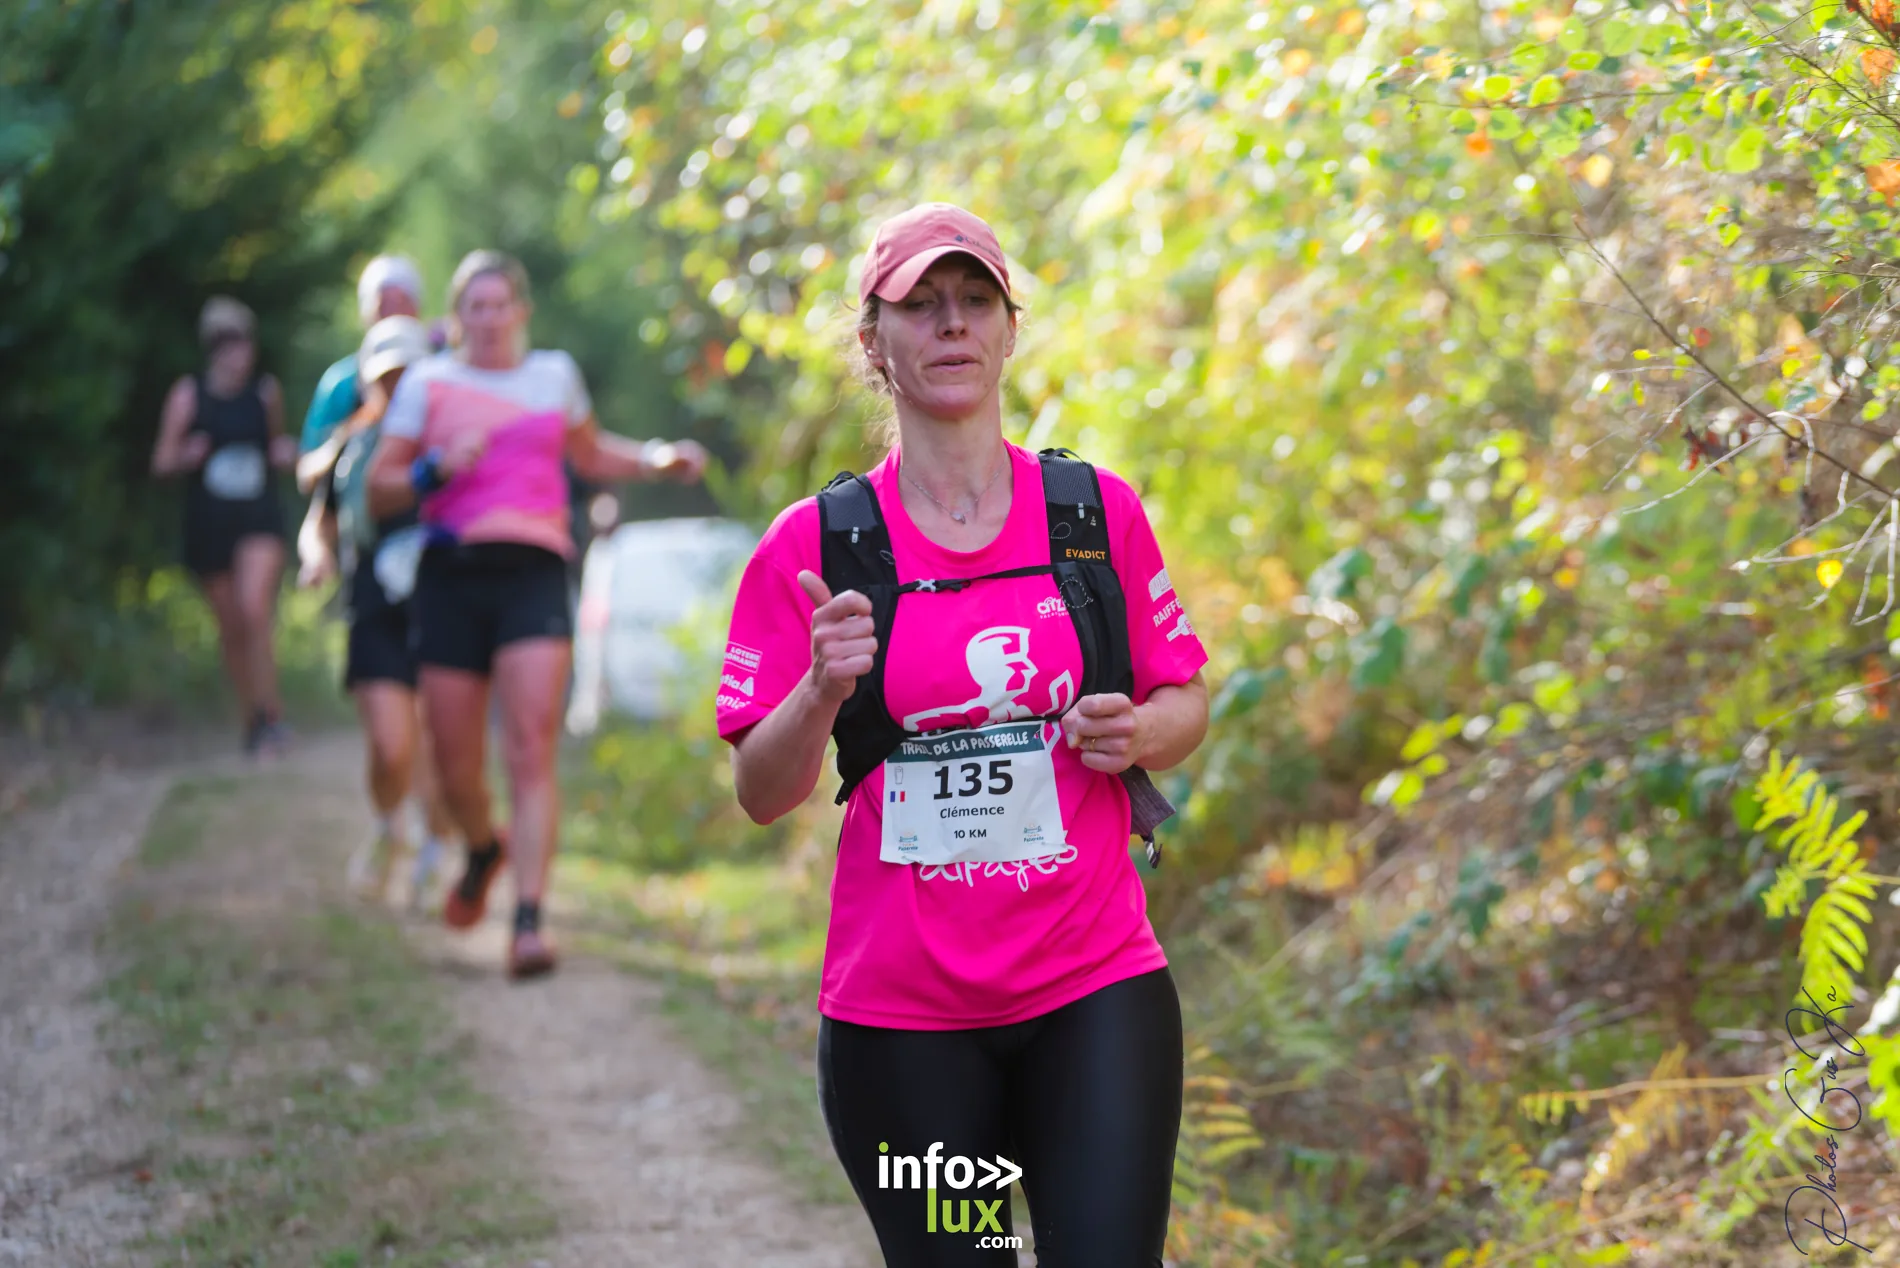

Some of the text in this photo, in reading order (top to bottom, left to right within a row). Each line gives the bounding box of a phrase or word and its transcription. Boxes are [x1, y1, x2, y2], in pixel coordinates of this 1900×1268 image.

[1065, 548, 1106, 560] EVADICT
[900, 731, 1029, 756] TRAIL DE LA PASSERELLE
[933, 759, 1014, 800] 135
[939, 804, 1005, 819] Clémence
[953, 829, 987, 839] 10 KM
